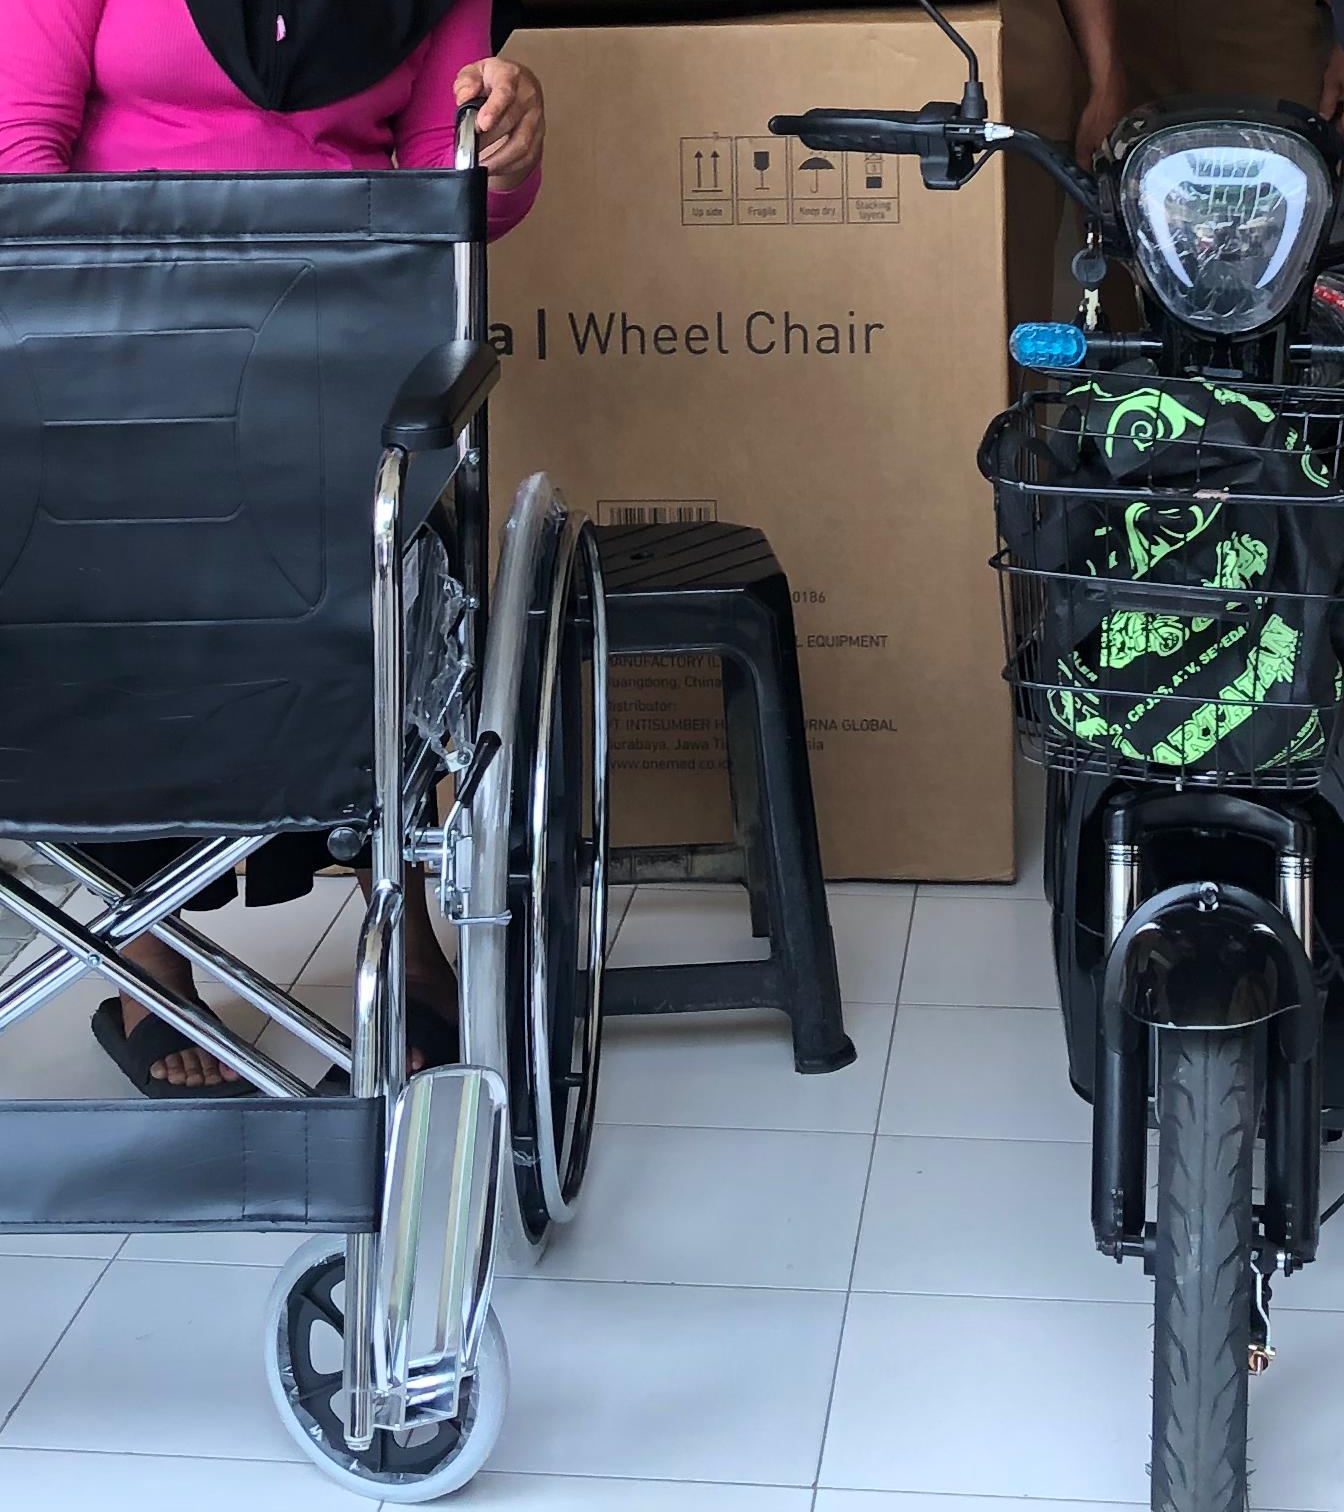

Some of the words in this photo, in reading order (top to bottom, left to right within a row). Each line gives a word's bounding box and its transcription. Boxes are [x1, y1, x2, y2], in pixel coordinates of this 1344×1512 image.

[747, 206, 777, 218] Fragile
[799, 206, 820, 218] Keep
[821, 205, 836, 217] dry
[567, 310, 729, 356] Wheel
[744, 310, 885, 356] Chair
[807, 635, 888, 648] EQUIPMENT
[608, 677, 681, 690] uangdong,
[625, 718, 710, 731] INTISUMBER
[841, 719, 898, 732] GLOBAL
[610, 737, 670, 753] urabaya,
[673, 738, 709, 751] Jawa
